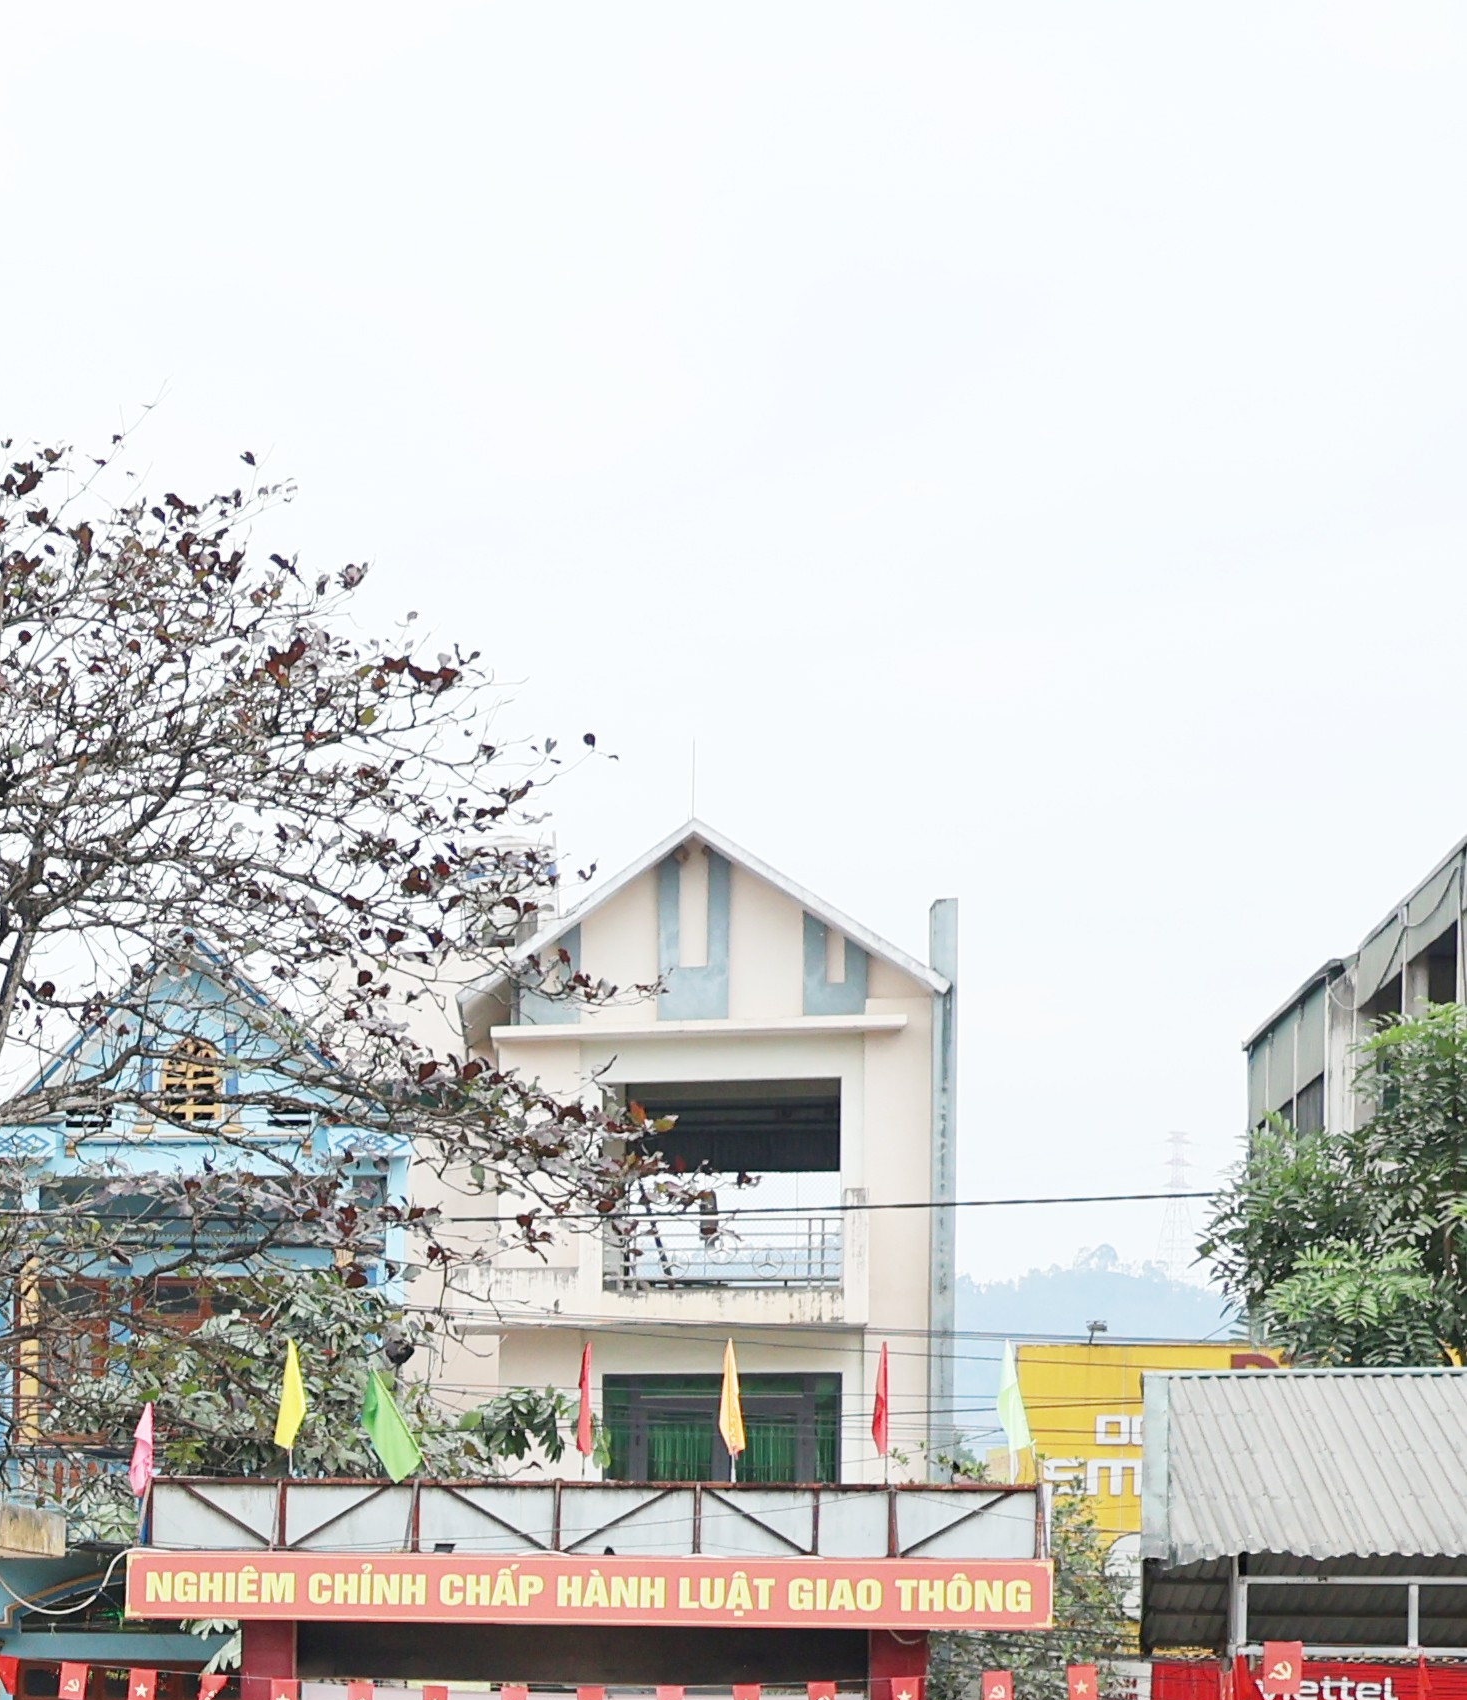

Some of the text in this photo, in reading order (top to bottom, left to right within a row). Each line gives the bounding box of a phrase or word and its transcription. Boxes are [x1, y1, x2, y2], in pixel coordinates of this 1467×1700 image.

[146, 1563, 1032, 1617] NGHIÊM CHỈNH CHẤP HÀNH LUẬT GIAO THÔNG
